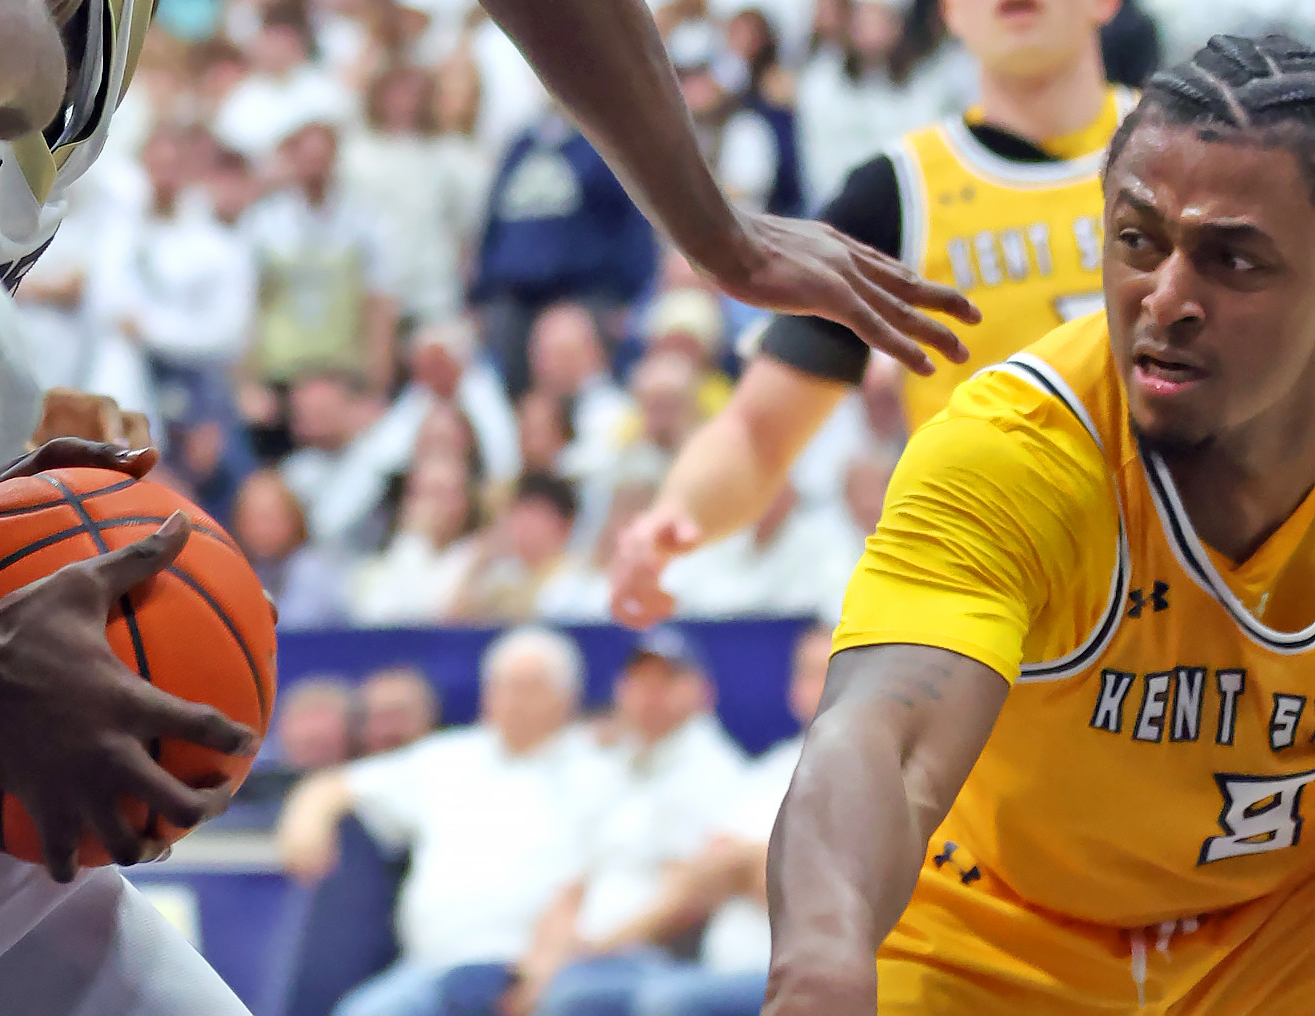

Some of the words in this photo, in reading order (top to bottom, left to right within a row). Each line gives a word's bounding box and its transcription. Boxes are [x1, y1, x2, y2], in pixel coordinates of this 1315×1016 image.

[947, 222, 1054, 290] KENT
[1089, 666, 1246, 745] KENT
[1269, 692, 1315, 752] S
